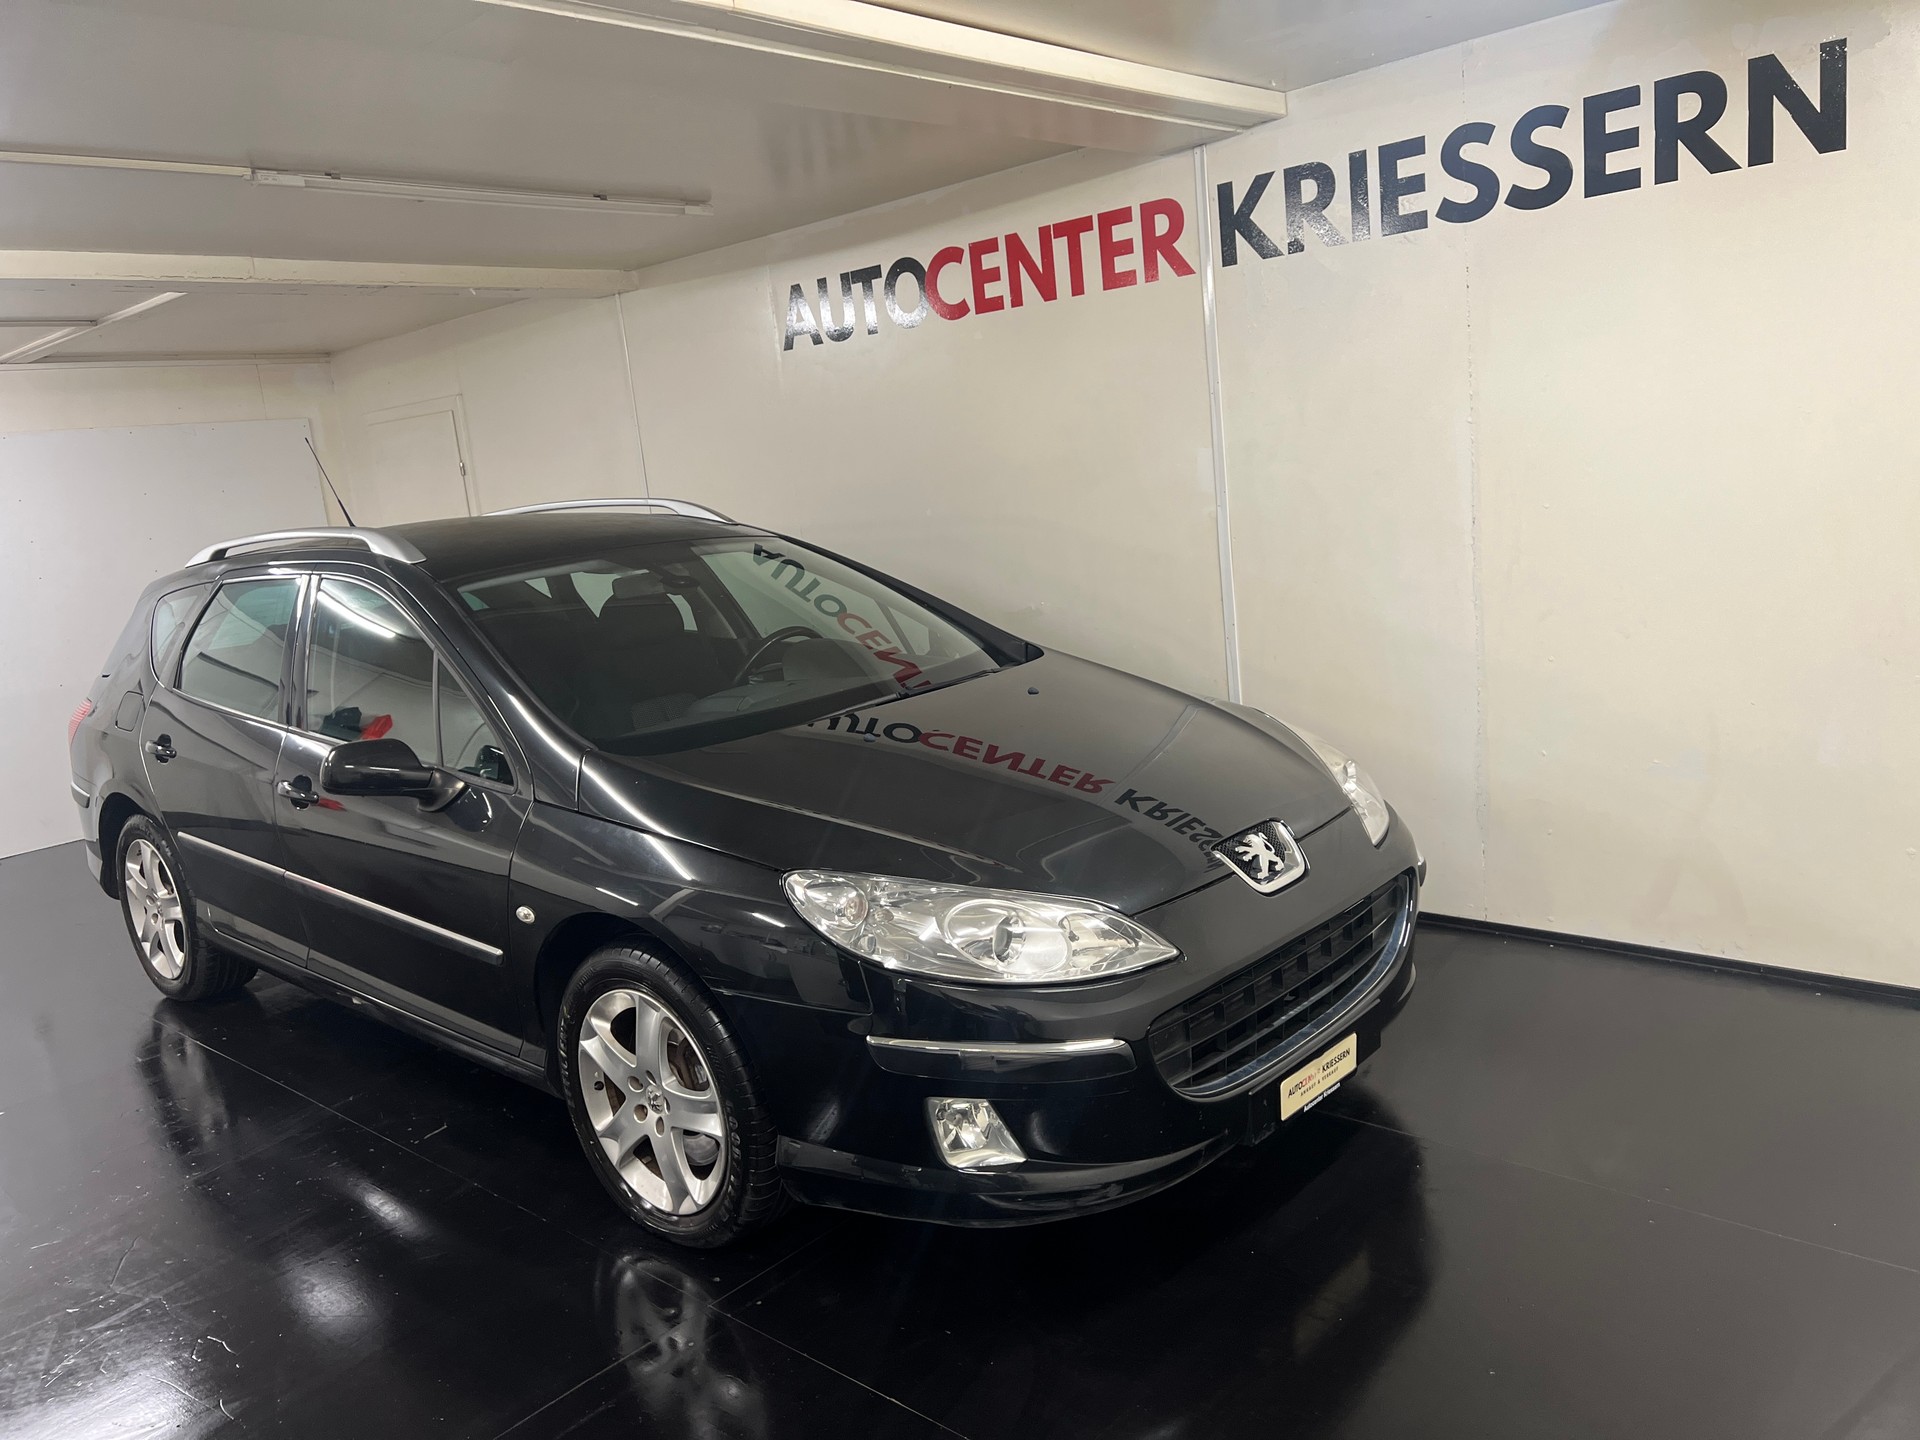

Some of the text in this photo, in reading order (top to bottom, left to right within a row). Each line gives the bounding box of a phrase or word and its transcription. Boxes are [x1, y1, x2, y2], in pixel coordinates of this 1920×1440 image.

[783, 37, 1848, 351] AUTOCENTER KRIESSERN
[1321, 1047, 1351, 1073] KRIESSERN
